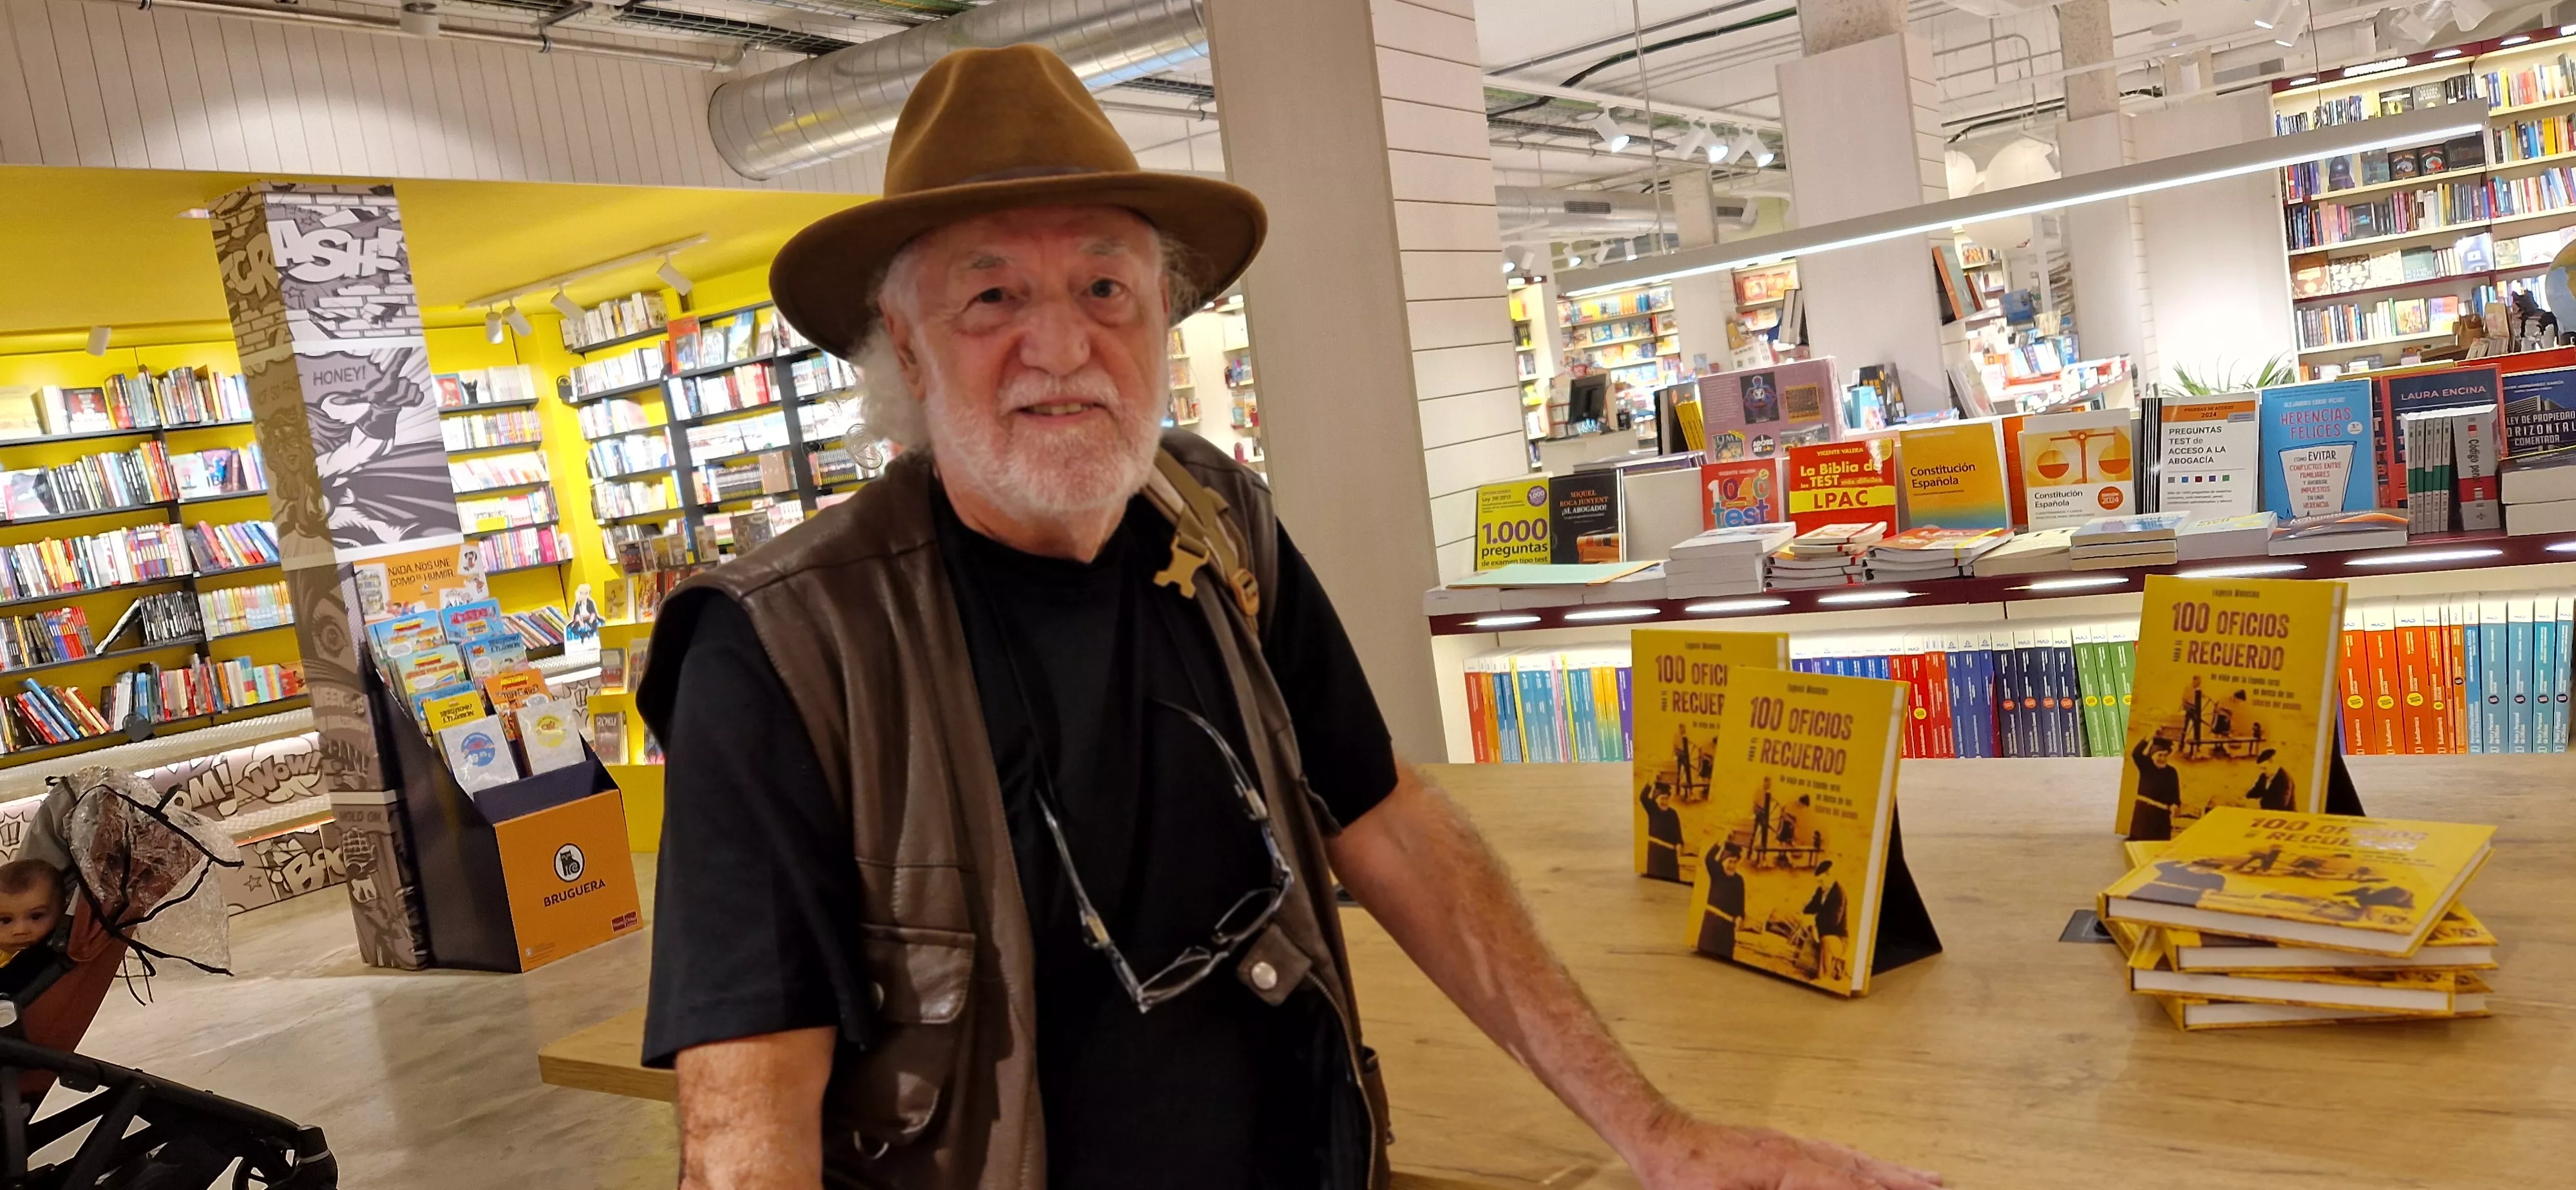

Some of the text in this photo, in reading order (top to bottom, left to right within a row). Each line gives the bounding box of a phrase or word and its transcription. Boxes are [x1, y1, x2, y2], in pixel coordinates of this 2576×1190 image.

[312, 364, 366, 386] HONEY!
[2401, 386, 2486, 401] LAURA ENCINA
[2281, 407, 2351, 425] HERENCIAS
[2506, 410, 2575, 426] LEY DE PROPIEDAD
[2168, 426, 2222, 435] PREGUNTAS
[2291, 424, 2341, 440] FELICES
[2506, 420, 2576, 437] ORIZONTAL
[1716, 434, 1741, 443] TIME
[2193, 437, 2203, 445] de
[2515, 434, 2560, 446] COMENTADA
[2168, 446, 2204, 455] ACCESO
[2214, 445, 2226, 453] LA
[2308, 450, 2336, 461] EVITAR
[2467, 439, 2479, 464] Código
[2168, 455, 2214, 465] ABOGACÍA
[1800, 460, 1881, 477] La Biblia de
[1910, 462, 1976, 477] Constitución
[1707, 476, 1770, 502] 1.040
[1810, 475, 1840, 487] TEST
[1911, 475, 1959, 489] Española
[1528, 491, 1546, 500] 1.000
[1570, 489, 1597, 498] MIQUEL
[1813, 490, 1869, 509] LPAC
[2034, 489, 2083, 500] Constitución
[2101, 496, 2119, 505] 2024
[1560, 496, 1609, 508] ROCA JUNYENT
[1573, 504, 1607, 515] ABOGADO!
[2034, 499, 2070, 509] Española
[1712, 498, 1770, 529] test
[1482, 518, 1548, 545] 1.000
[1481, 542, 1548, 559] preguntas
[388, 558, 451, 576] NADA NOS UNE
[1519, 557, 1533, 565] tipo
[390, 576, 415, 588] COMO
[423, 569, 455, 581] HUMOR
[2172, 601, 2290, 639] 100 OFICIOS
[2186, 640, 2285, 671] RECUERDO
[1655, 654, 1728, 686] 100 OFICI
[1672, 690, 1726, 716] RECUER
[1750, 696, 1853, 741] 100 OFICIOS
[1760, 738, 1847, 775] RECUERDO
[234, 750, 323, 798] WOW!
[2251, 817, 2311, 831] 100
[543, 878, 607, 908] BRUGUERA
